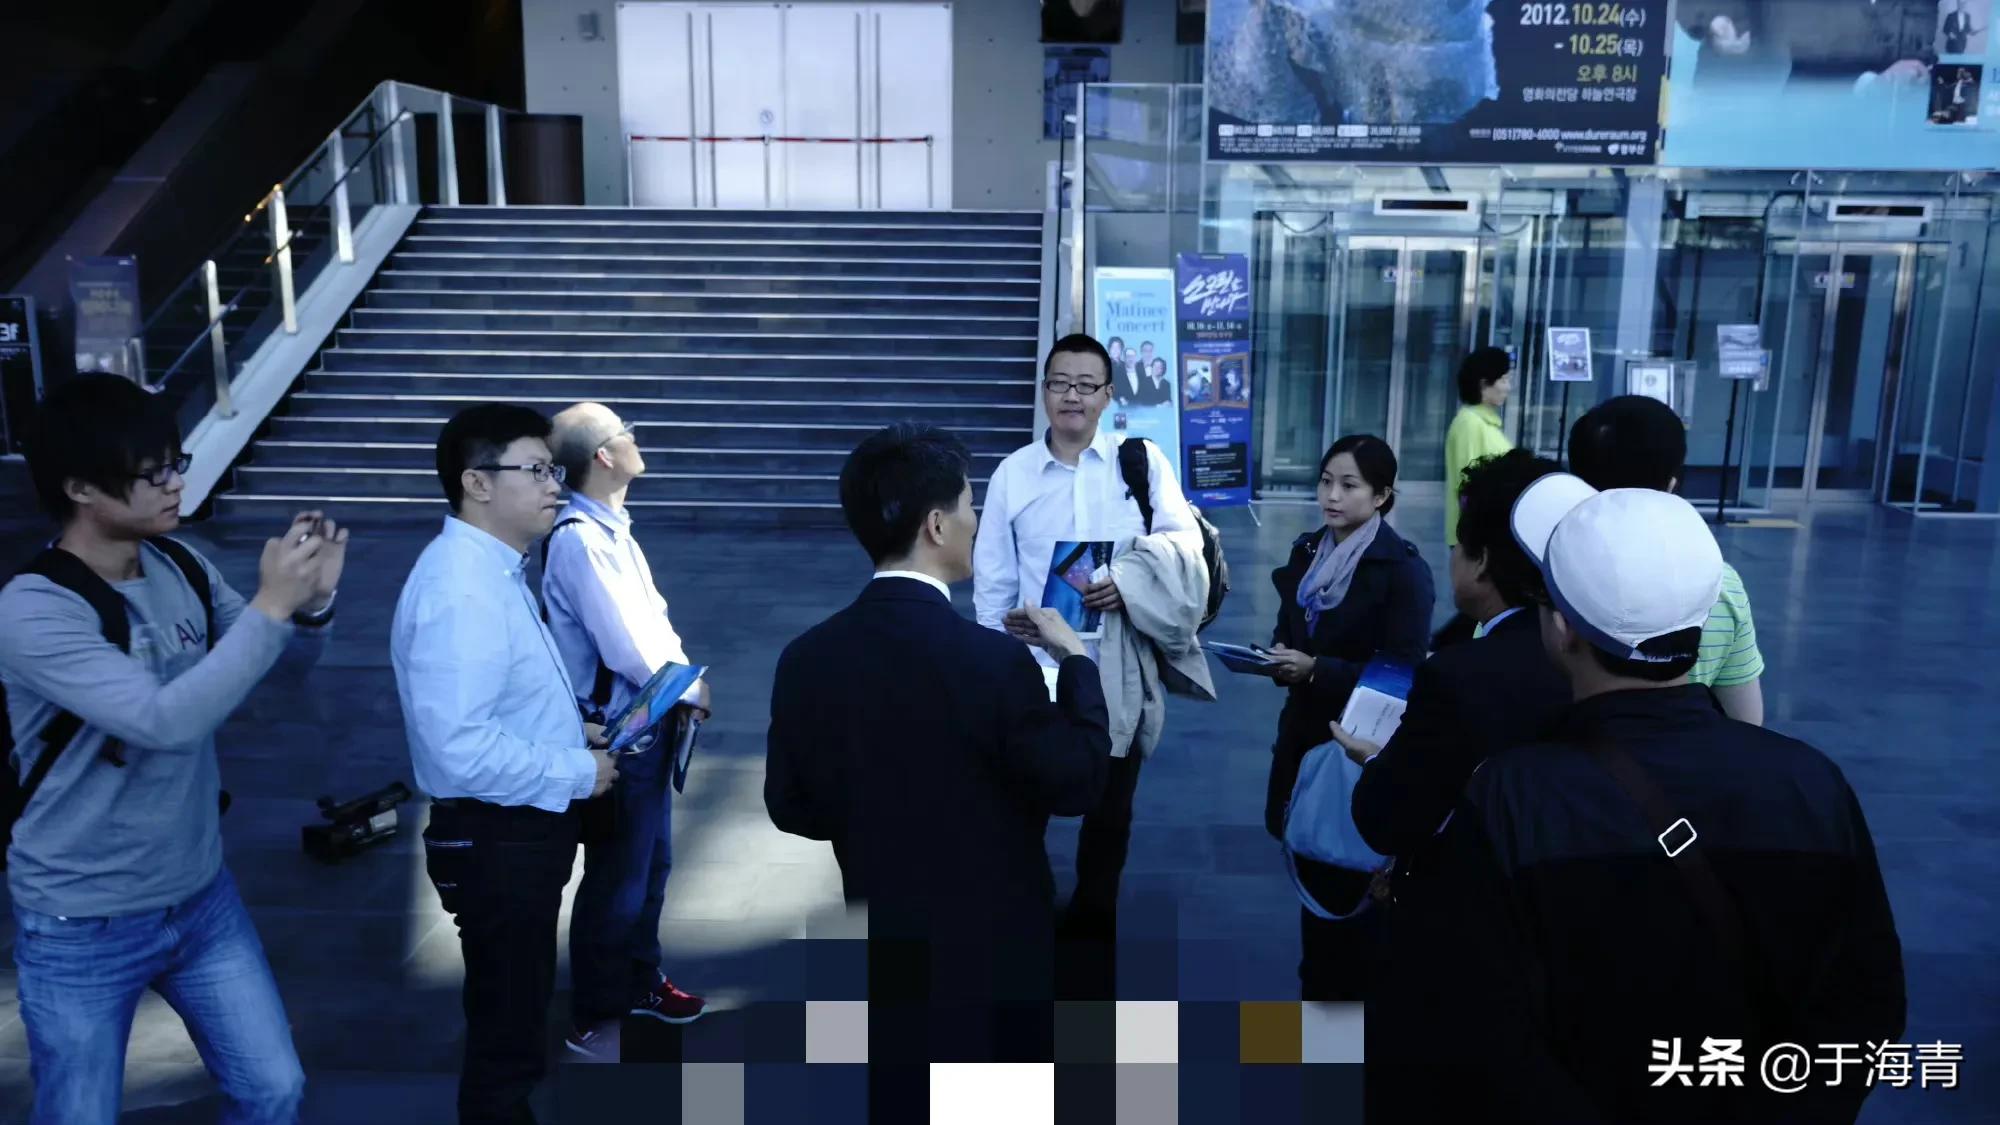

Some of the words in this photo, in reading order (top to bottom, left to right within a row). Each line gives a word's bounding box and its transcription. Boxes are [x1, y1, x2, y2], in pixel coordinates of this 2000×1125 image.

[1569, 33, 1643, 56] 10.25(목)
[1577, 64, 1607, 82] 오후
[1611, 64, 1638, 82] 8시
[1106, 301, 1168, 318] Matinee
[1106, 319, 1166, 334] Concert
